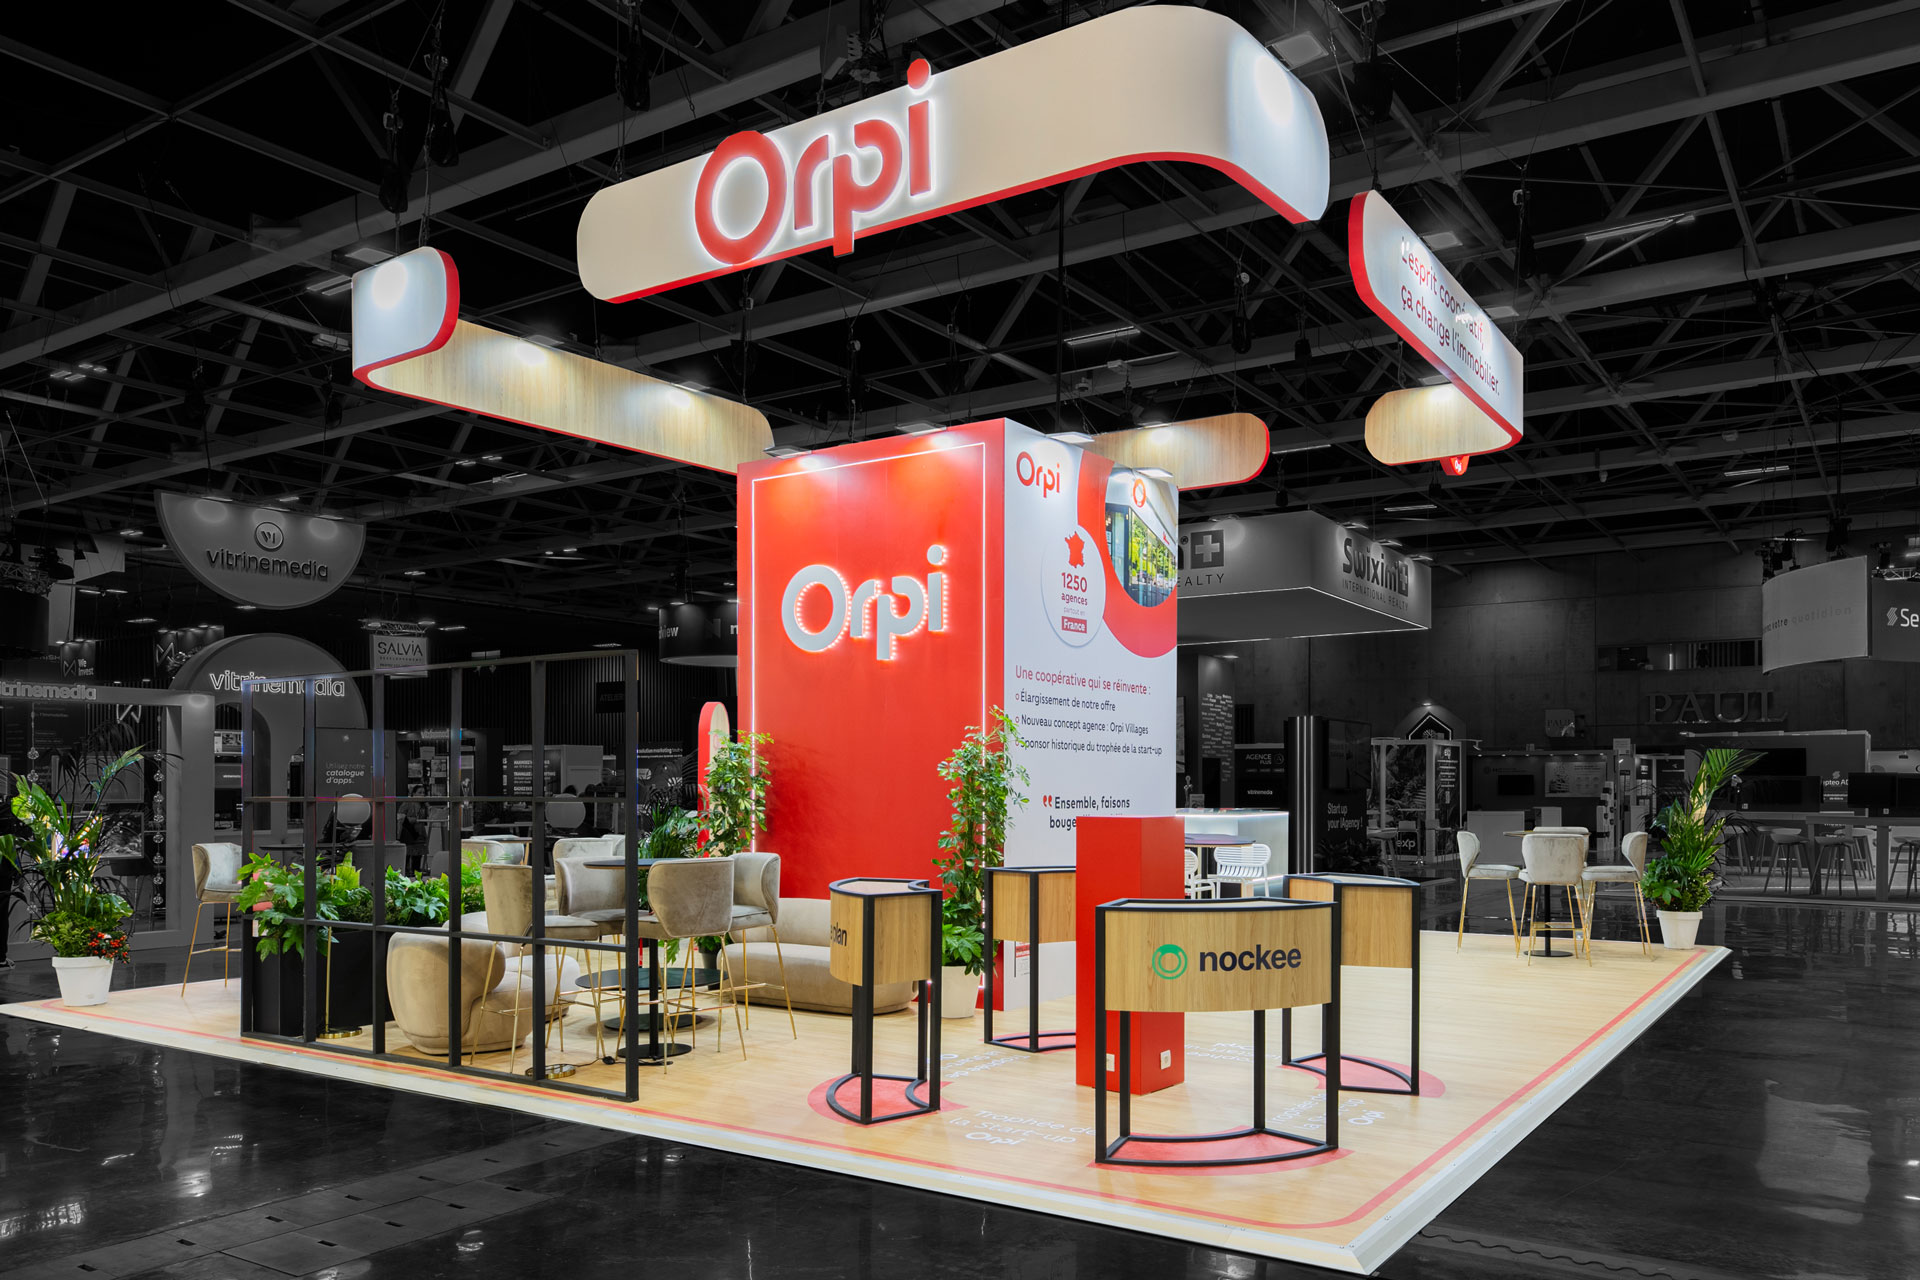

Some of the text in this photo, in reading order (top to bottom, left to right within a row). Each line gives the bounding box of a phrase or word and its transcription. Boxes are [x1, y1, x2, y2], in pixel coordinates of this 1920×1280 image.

[694, 58, 932, 265] Orpi
[1400, 236, 1437, 296] L'esprit
[1401, 284, 1500, 396] ça change l'immobilier.
[1016, 451, 1061, 498] Orpi
[206, 548, 329, 579] vitrinemedia
[1061, 572, 1088, 593] 1250
[781, 544, 947, 660] Orpi
[1061, 592, 1088, 606] agences
[1063, 618, 1086, 632] France
[0, 681, 97, 700] trinemedia
[209, 670, 345, 697] vitrinemdia
[1015, 664, 1033, 680] Une
[1035, 670, 1086, 687] coopérative
[1088, 676, 1101, 692] qui
[1102, 680, 1111, 690] se
[1112, 679, 1148, 695] réinvente
[1020, 688, 1116, 711] Élargissement de notre offre
[1645, 690, 1788, 724] PAUL
[1021, 714, 1053, 728] Nouveau
[1053, 718, 1081, 732] concept
[1082, 721, 1106, 733] agence
[1109, 722, 1124, 734] Orpi
[1125, 723, 1149, 737] Villages
[1020, 737, 1163, 756] Sponsor historique du trophée de la start-up
[325, 769, 365, 778] catalogue
[1054, 795, 1130, 811] Ensemble, faisons
[1396, 838, 1416, 850] exp
[1199, 944, 1302, 972] nockee
[950, 1117, 971, 1127] la
[975, 1110, 1065, 1130] Trophée
[1347, 1109, 1385, 1126] Orpi
[965, 1131, 1025, 1145] Orpi
